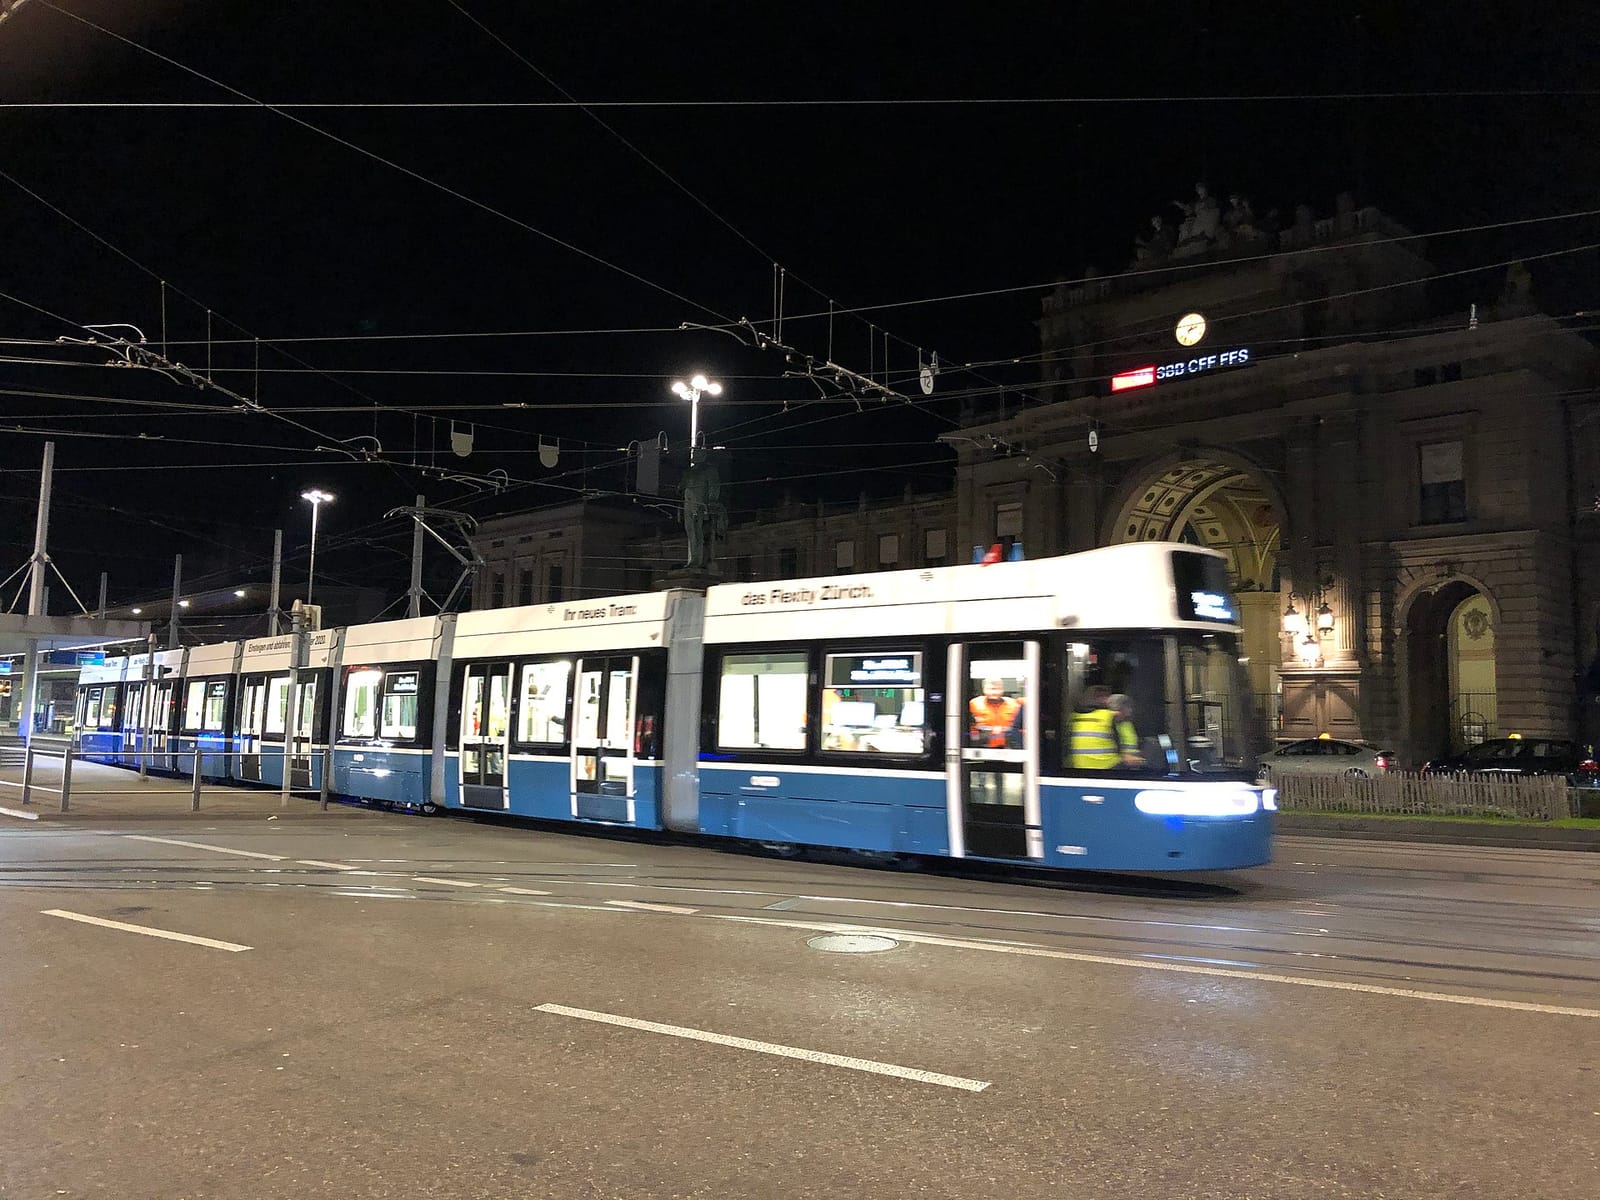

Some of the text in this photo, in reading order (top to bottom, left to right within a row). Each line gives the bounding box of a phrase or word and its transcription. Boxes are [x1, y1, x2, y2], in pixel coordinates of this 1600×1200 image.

[1156, 349, 1249, 379] SBB CFF FFS
[741, 592, 766, 606] das
[578, 607, 607, 620] neues
